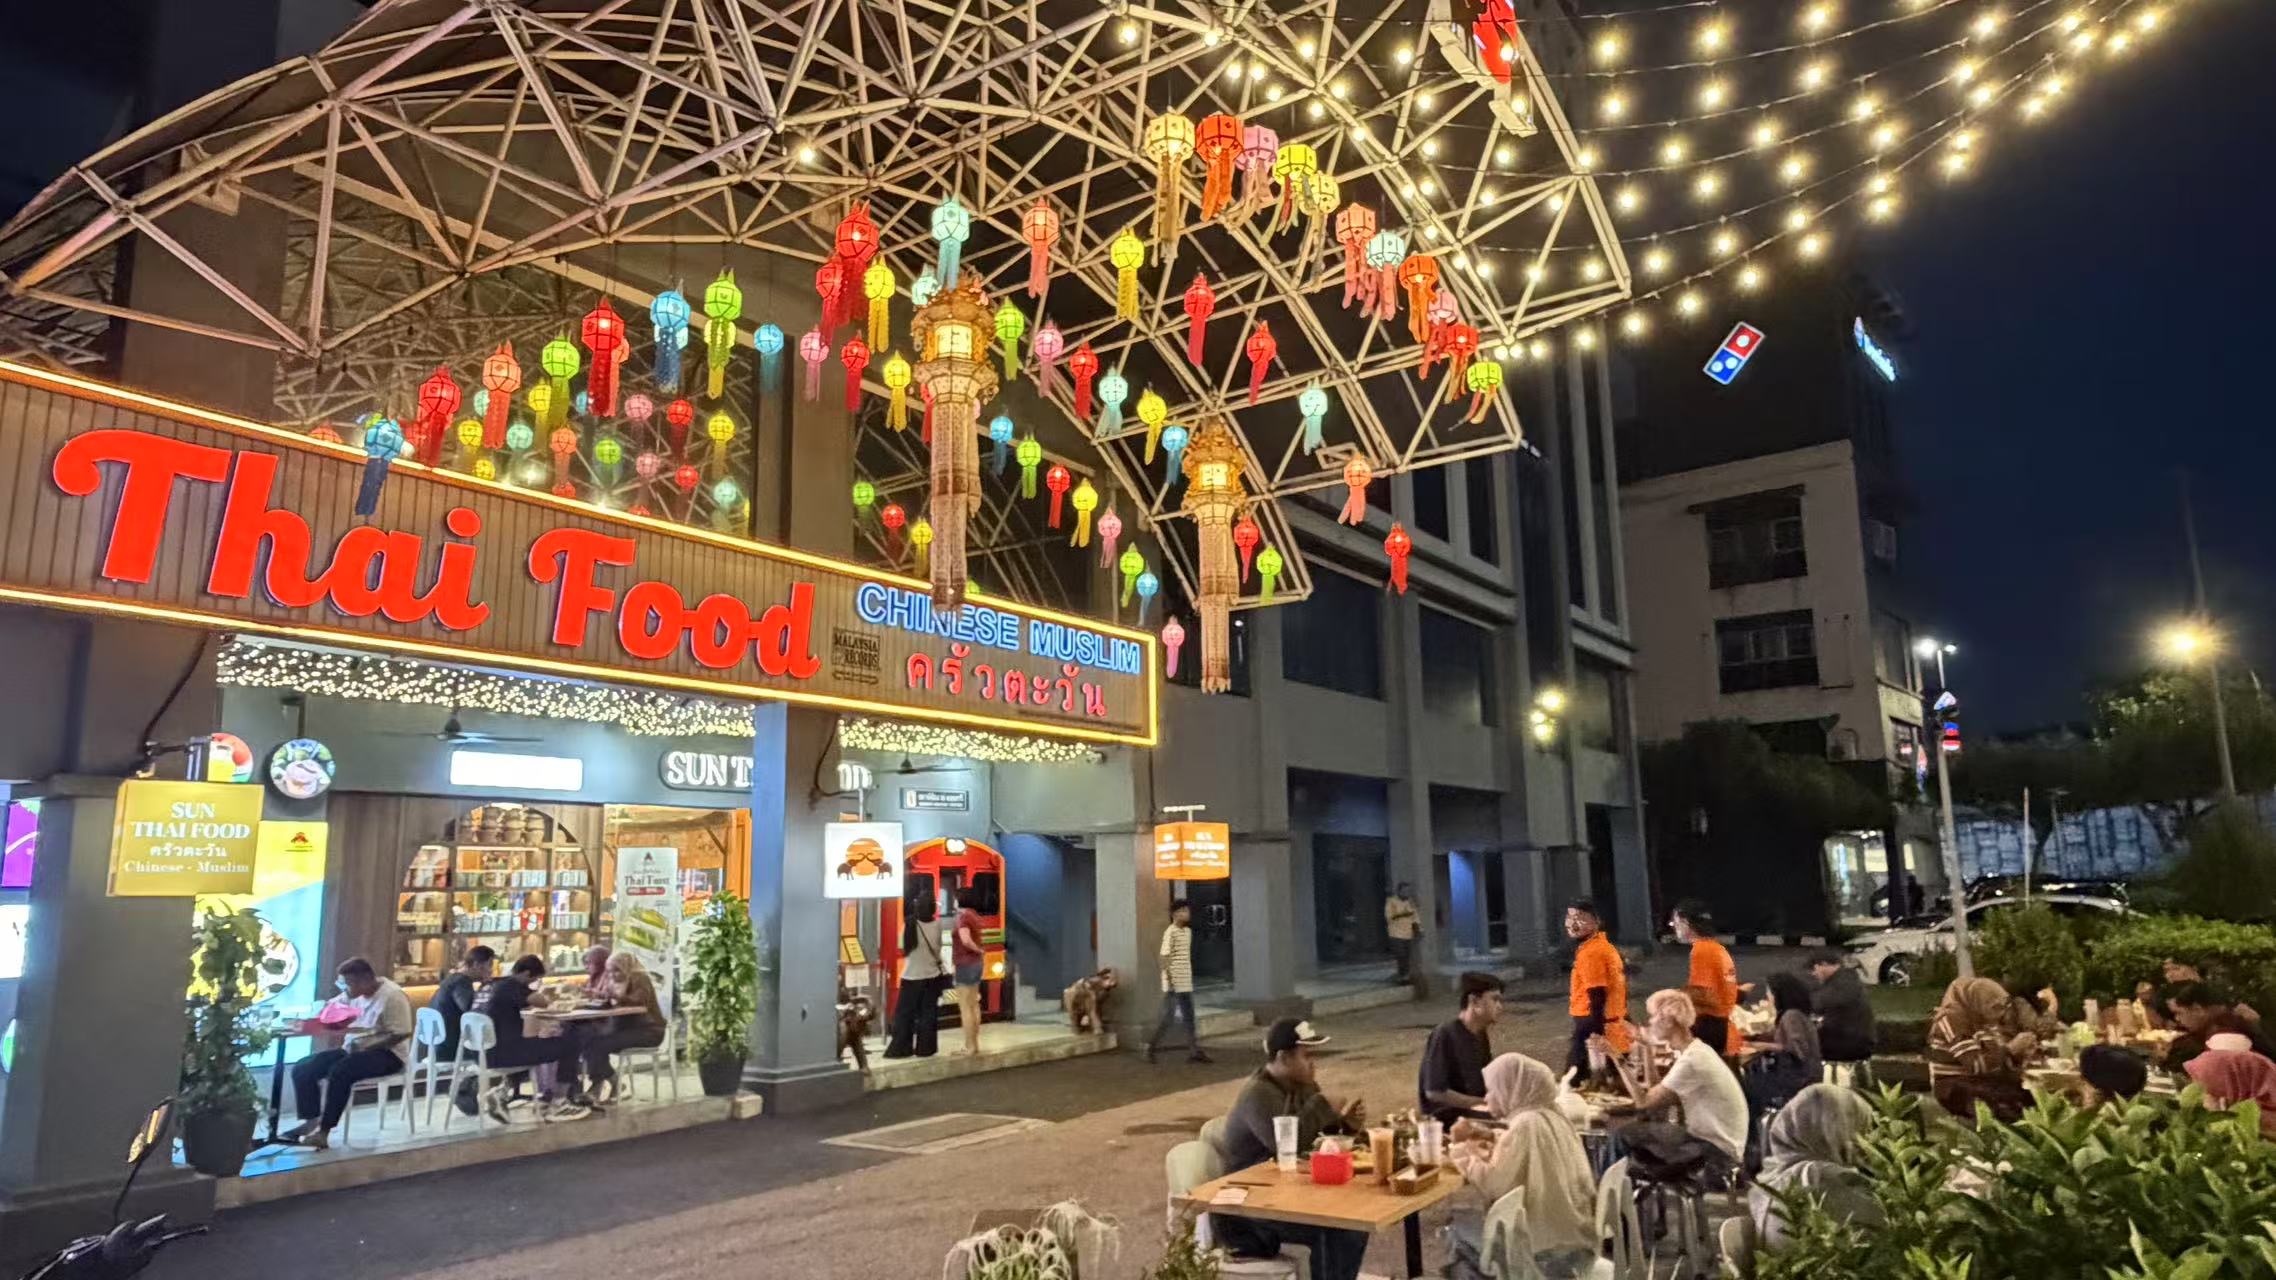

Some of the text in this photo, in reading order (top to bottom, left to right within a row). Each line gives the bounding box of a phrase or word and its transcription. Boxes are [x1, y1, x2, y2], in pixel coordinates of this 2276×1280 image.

[52, 429, 821, 680] Thai Food
[857, 582, 1141, 675] CHINESE MUSLIM
[906, 641, 1106, 717] ครัวตะวัน
[668, 750, 728, 787] SUN
[171, 801, 215, 819] SUN
[131, 820, 250, 840] THAI FOOD
[124, 859, 184, 873] Chinese
[196, 860, 250, 874] Muslim
